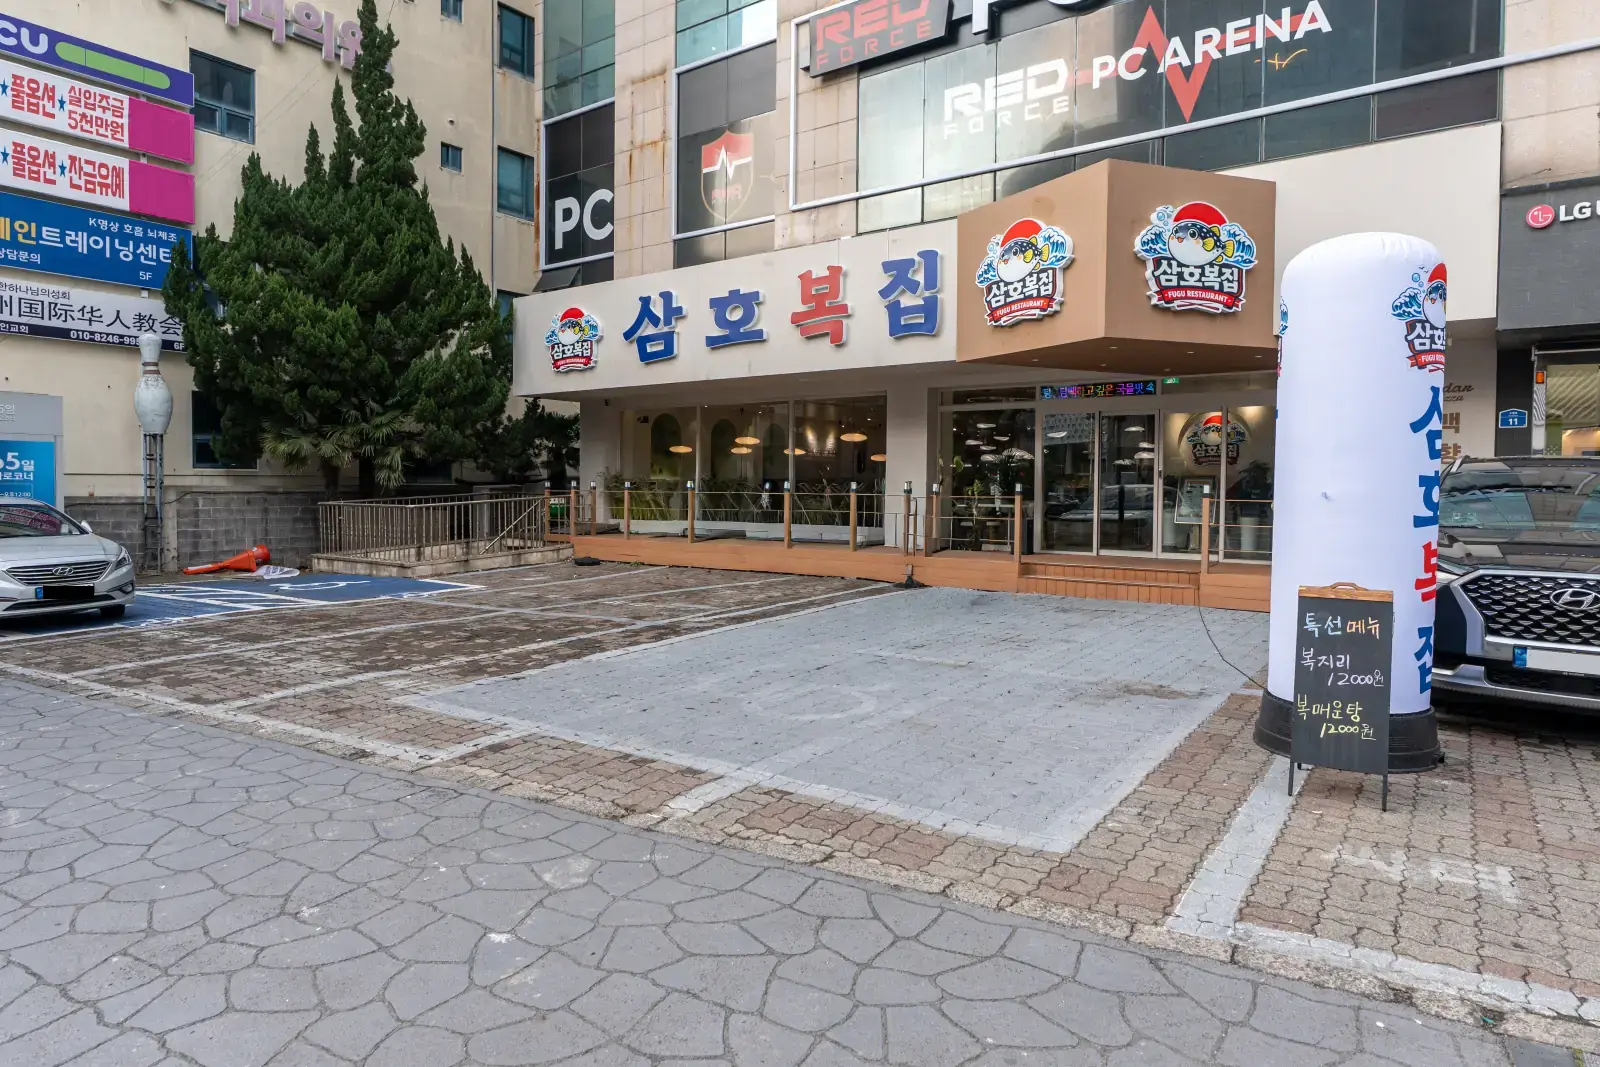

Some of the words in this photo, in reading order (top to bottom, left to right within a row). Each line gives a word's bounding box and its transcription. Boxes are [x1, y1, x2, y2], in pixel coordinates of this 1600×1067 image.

[0, 20, 48, 54] CU
[816, 0, 930, 50] RED
[816, 20, 932, 69] FORCE
[1092, 47, 1145, 88] PC
[1157, 0, 1332, 74] ARENA
[11, 73, 56, 120] 풀옵션
[68, 85, 125, 119] 실입주금
[944, 58, 1068, 121] RED
[67, 109, 125, 143] 5천만원
[944, 96, 1068, 139] FORCE
[12, 141, 57, 186] 풀옵션
[68, 154, 125, 199] 잔금유예
[555, 189, 614, 249] PC
[1559, 201, 1592, 222] LG
[139, 271, 153, 281] 5F
[986, 269, 1053, 308] 삼호복집
[1153, 259, 1239, 294] 삼호복집
[622, 249, 940, 364] 삼호복집
[996, 307, 1012, 318] FUGU
[1011, 300, 1045, 312] RESTAURANT
[1167, 290, 1187, 299] FUGU
[1186, 290, 1229, 304] RESTAURANT
[552, 341, 591, 360] 삼호복집
[1508, 418, 1518, 426] 11
[1303, 612, 1342, 638] 특선
[1346, 616, 1380, 640] 메뉴
[1300, 646, 1350, 672] 복지리
[1327, 669, 1385, 687] 12000원
[1297, 693, 1363, 722] 복매운탕
[1319, 722, 1377, 741] 12000원
